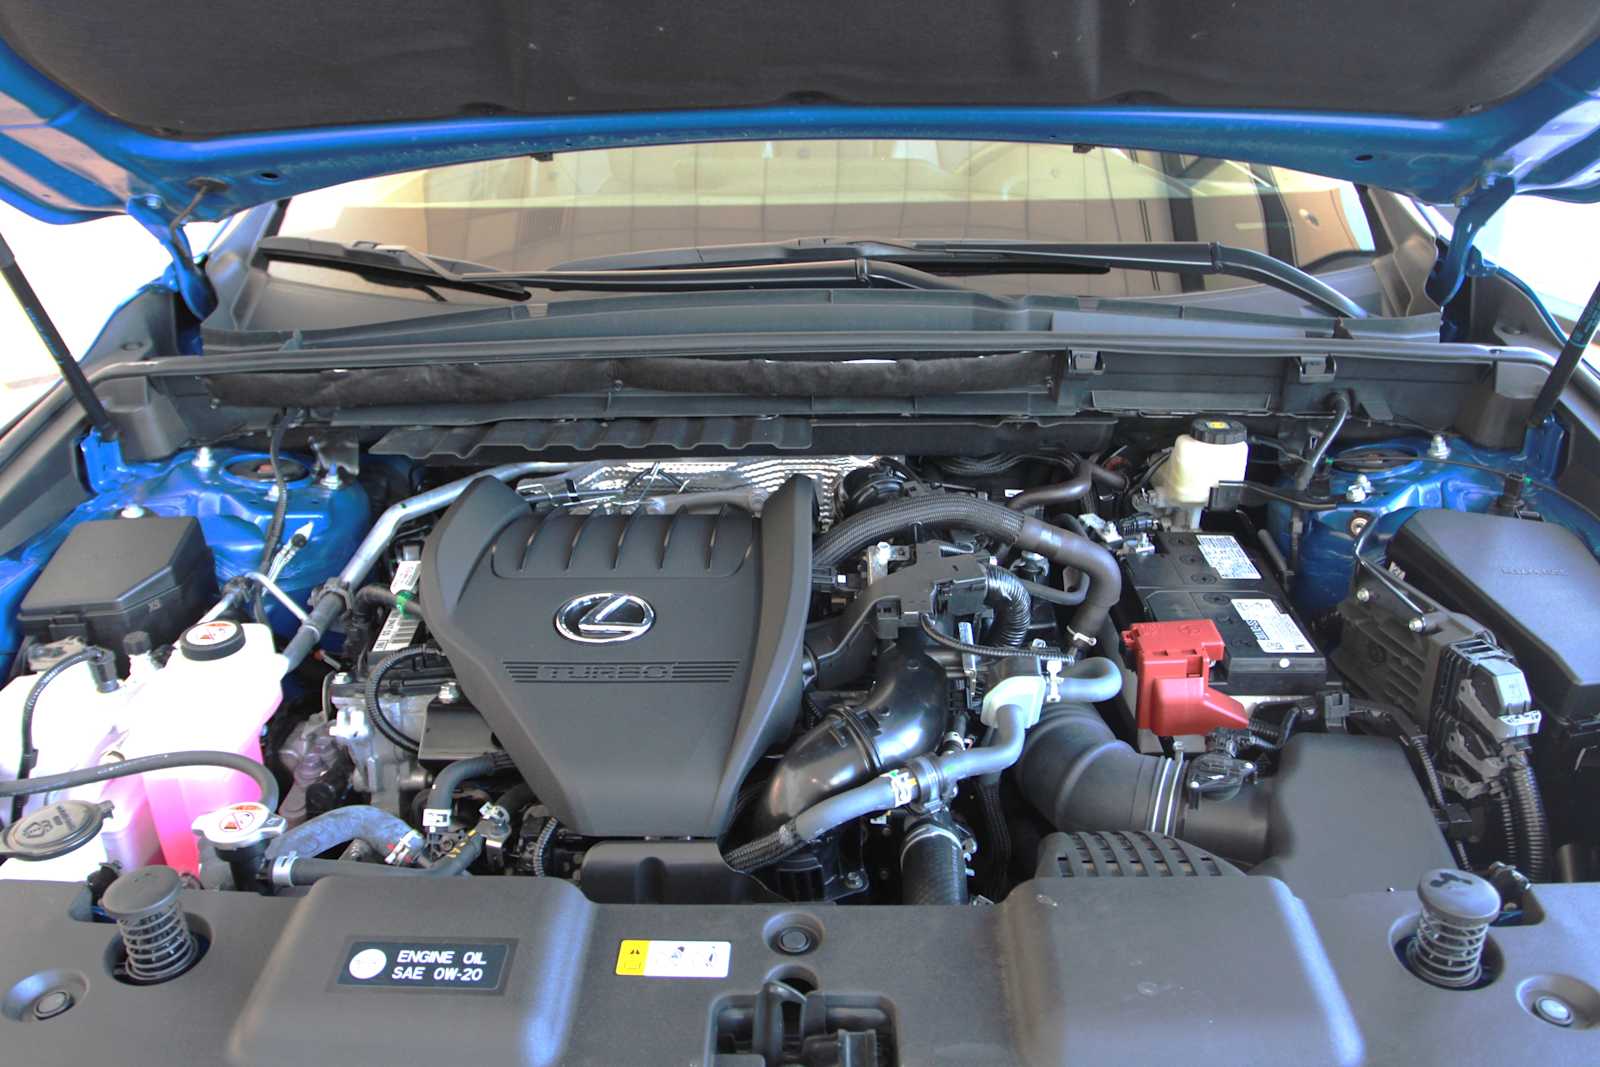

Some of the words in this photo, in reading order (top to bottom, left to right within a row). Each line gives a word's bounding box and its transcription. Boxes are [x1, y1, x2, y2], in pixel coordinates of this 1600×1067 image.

[541, 665, 669, 680] TURBO
[397, 950, 454, 964] ENGINE
[463, 951, 487, 965] OIL
[391, 966, 425, 980] SAE
[433, 967, 483, 981] 0W-20
